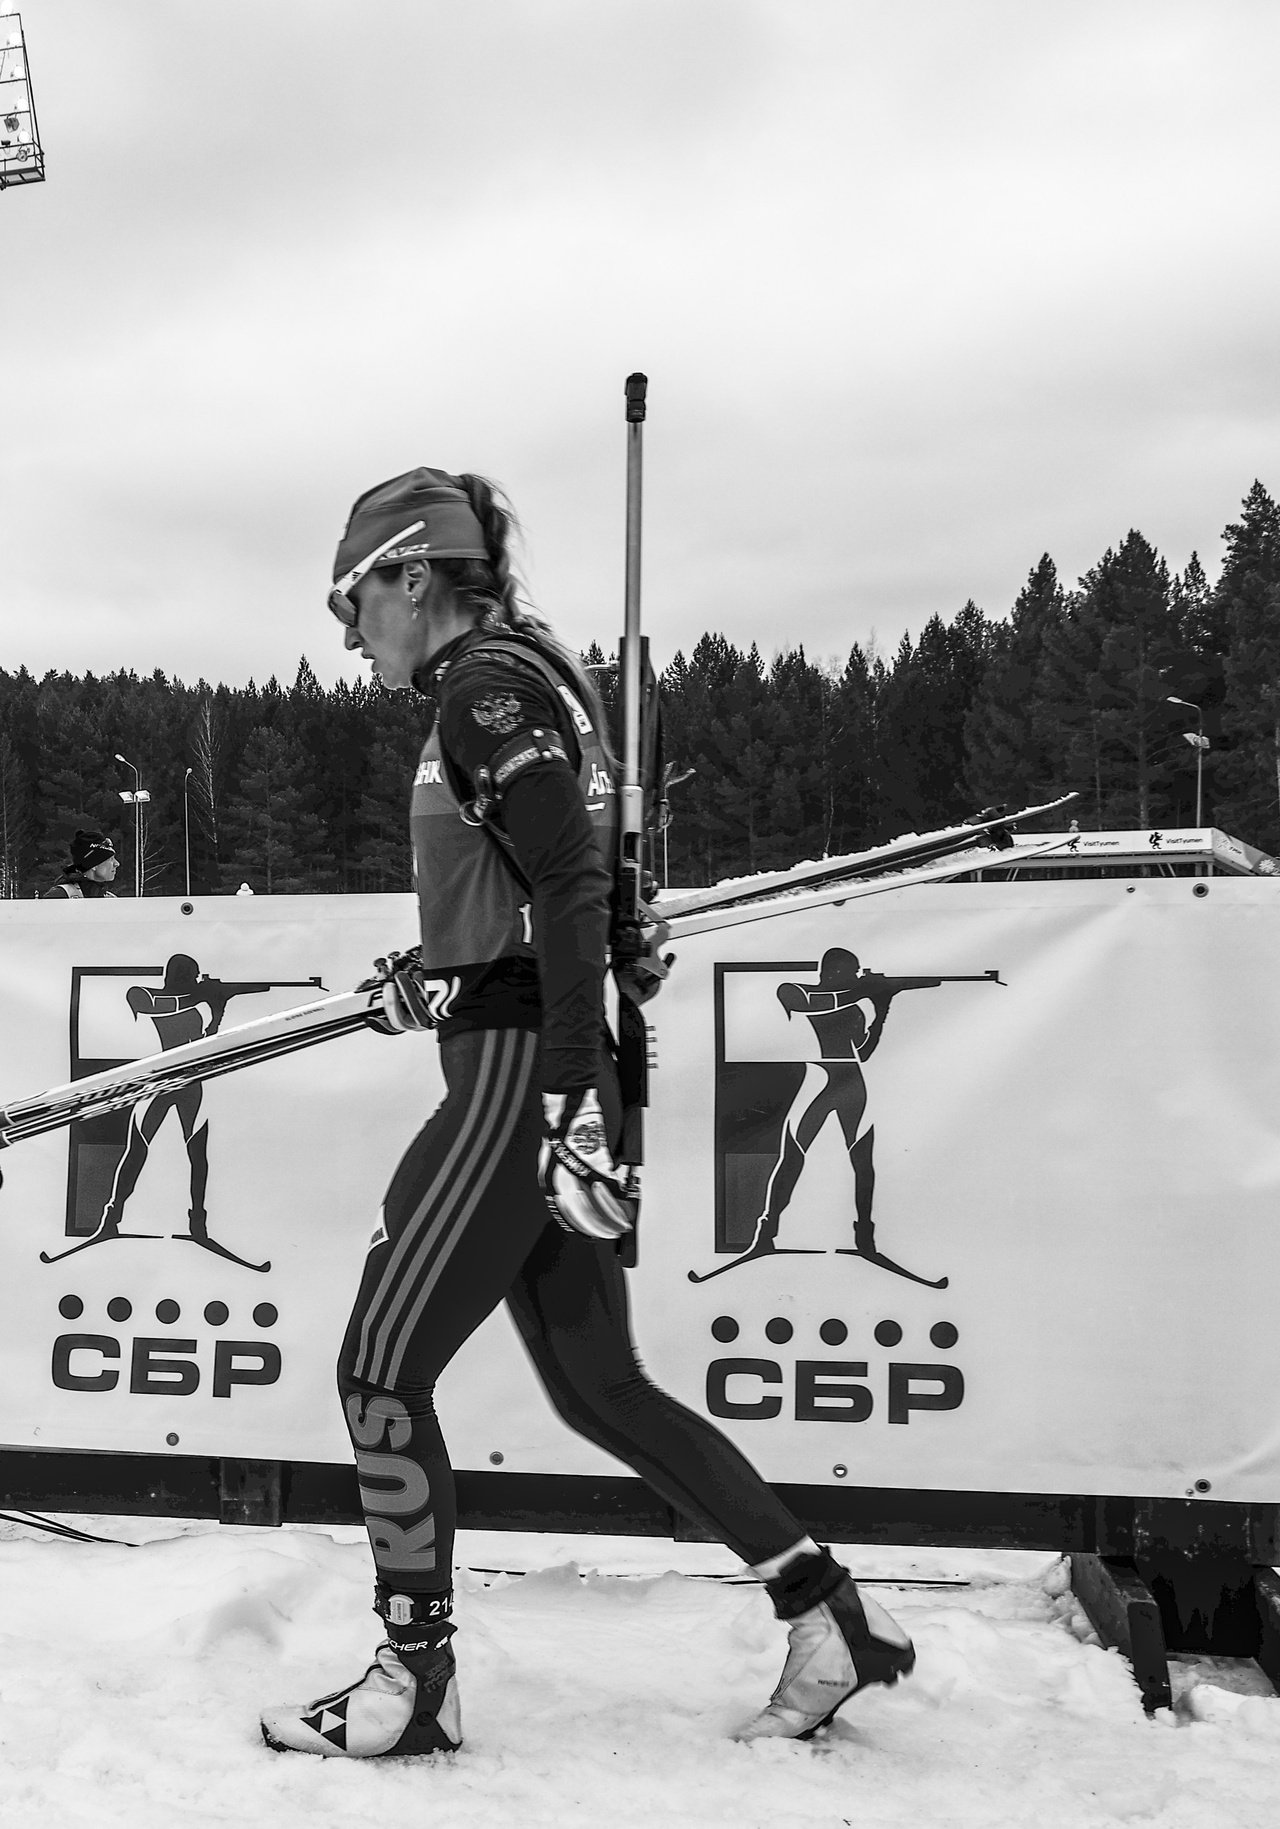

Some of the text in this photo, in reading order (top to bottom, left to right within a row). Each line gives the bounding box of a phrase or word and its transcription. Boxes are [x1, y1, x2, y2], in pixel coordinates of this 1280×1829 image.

[518, 903, 533, 944] 1
[52, 1333, 282, 1398] СБР
[706, 1357, 964, 1424] СБР
[345, 1392, 436, 1572] RUS
